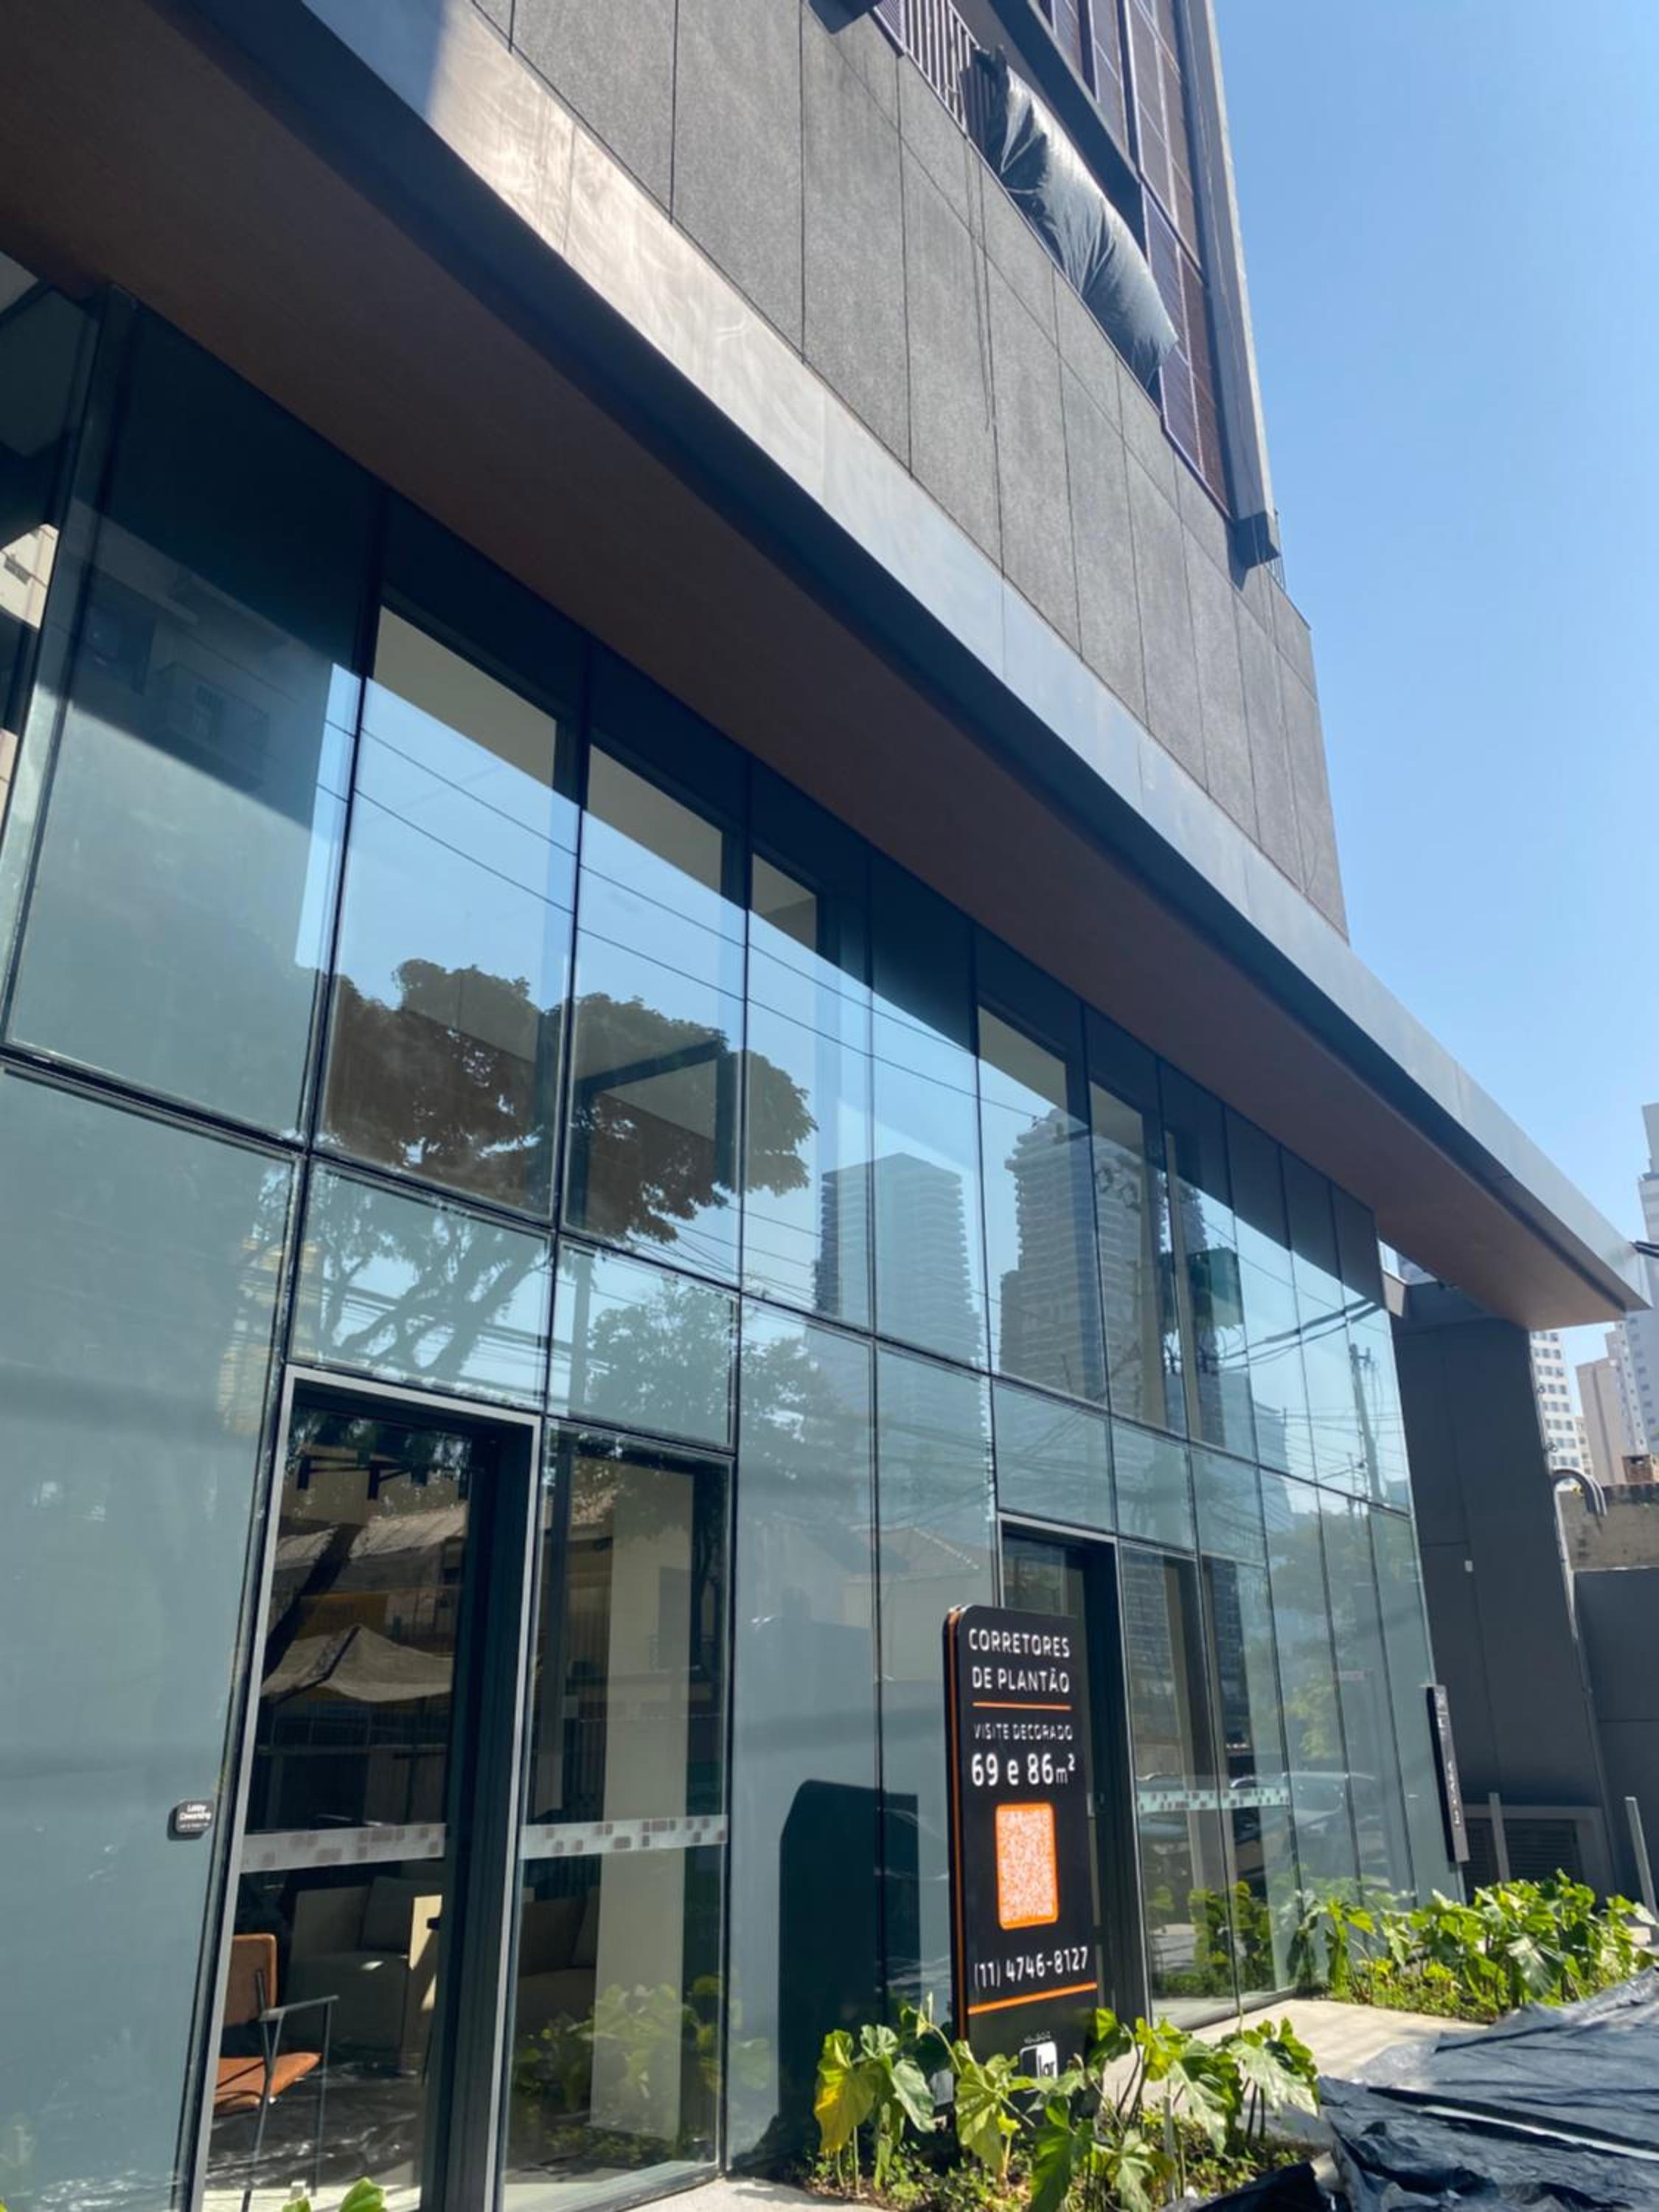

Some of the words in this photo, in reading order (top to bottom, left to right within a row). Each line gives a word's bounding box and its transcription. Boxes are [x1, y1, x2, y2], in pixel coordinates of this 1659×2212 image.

[969, 1628, 1070, 1658] CORRETORES
[973, 1666, 992, 1688] DE
[998, 1667, 1070, 1693] PLANTÃO
[974, 1723, 1009, 1740] VISITE
[1012, 1723, 1073, 1740] DECORADO
[972, 1753, 998, 1787] 69
[1007, 1759, 1019, 1786] e
[974, 1961, 1001, 1989] (11)
[1006, 1946, 1088, 1982] 4746-8127
